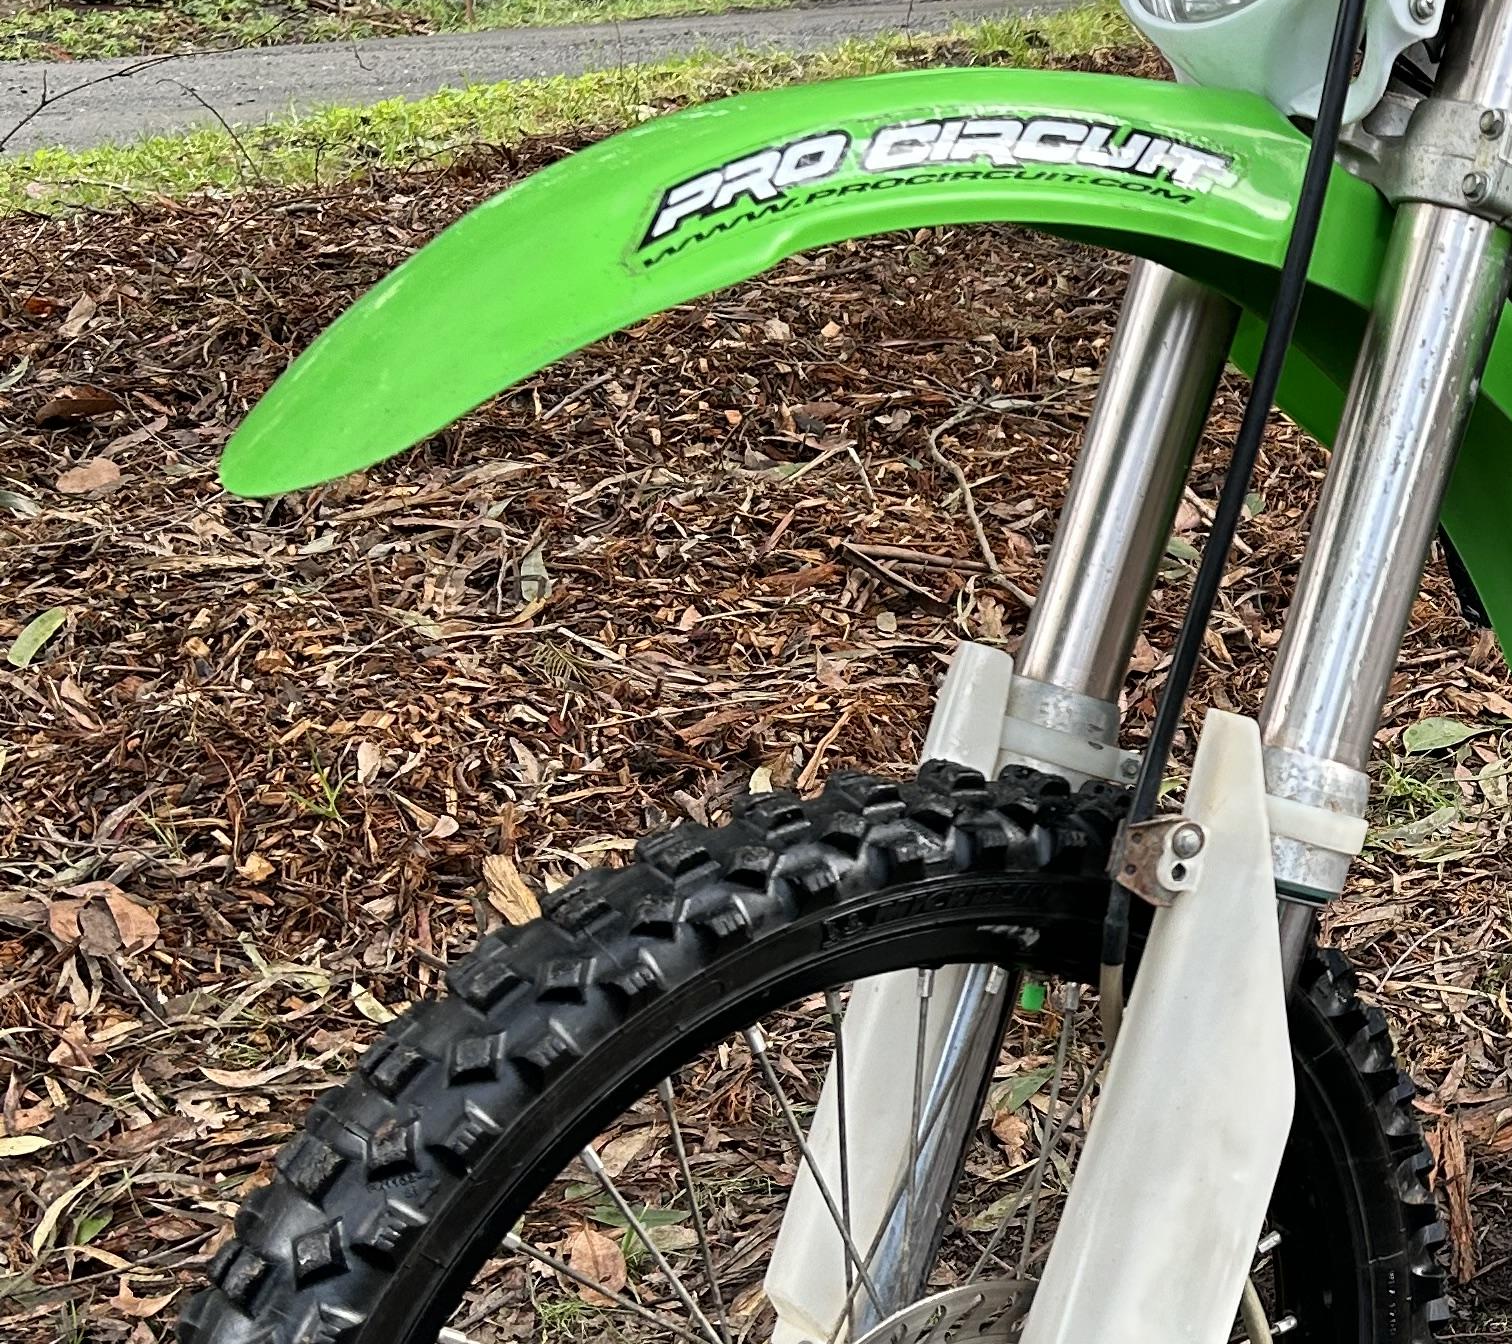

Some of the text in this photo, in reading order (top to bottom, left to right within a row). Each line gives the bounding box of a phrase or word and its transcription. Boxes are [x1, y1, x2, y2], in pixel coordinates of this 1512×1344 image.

[639, 118, 1241, 250] PRO CIRCUIT
[643, 169, 1196, 268] WWW.PROCIRCUIT.COM
